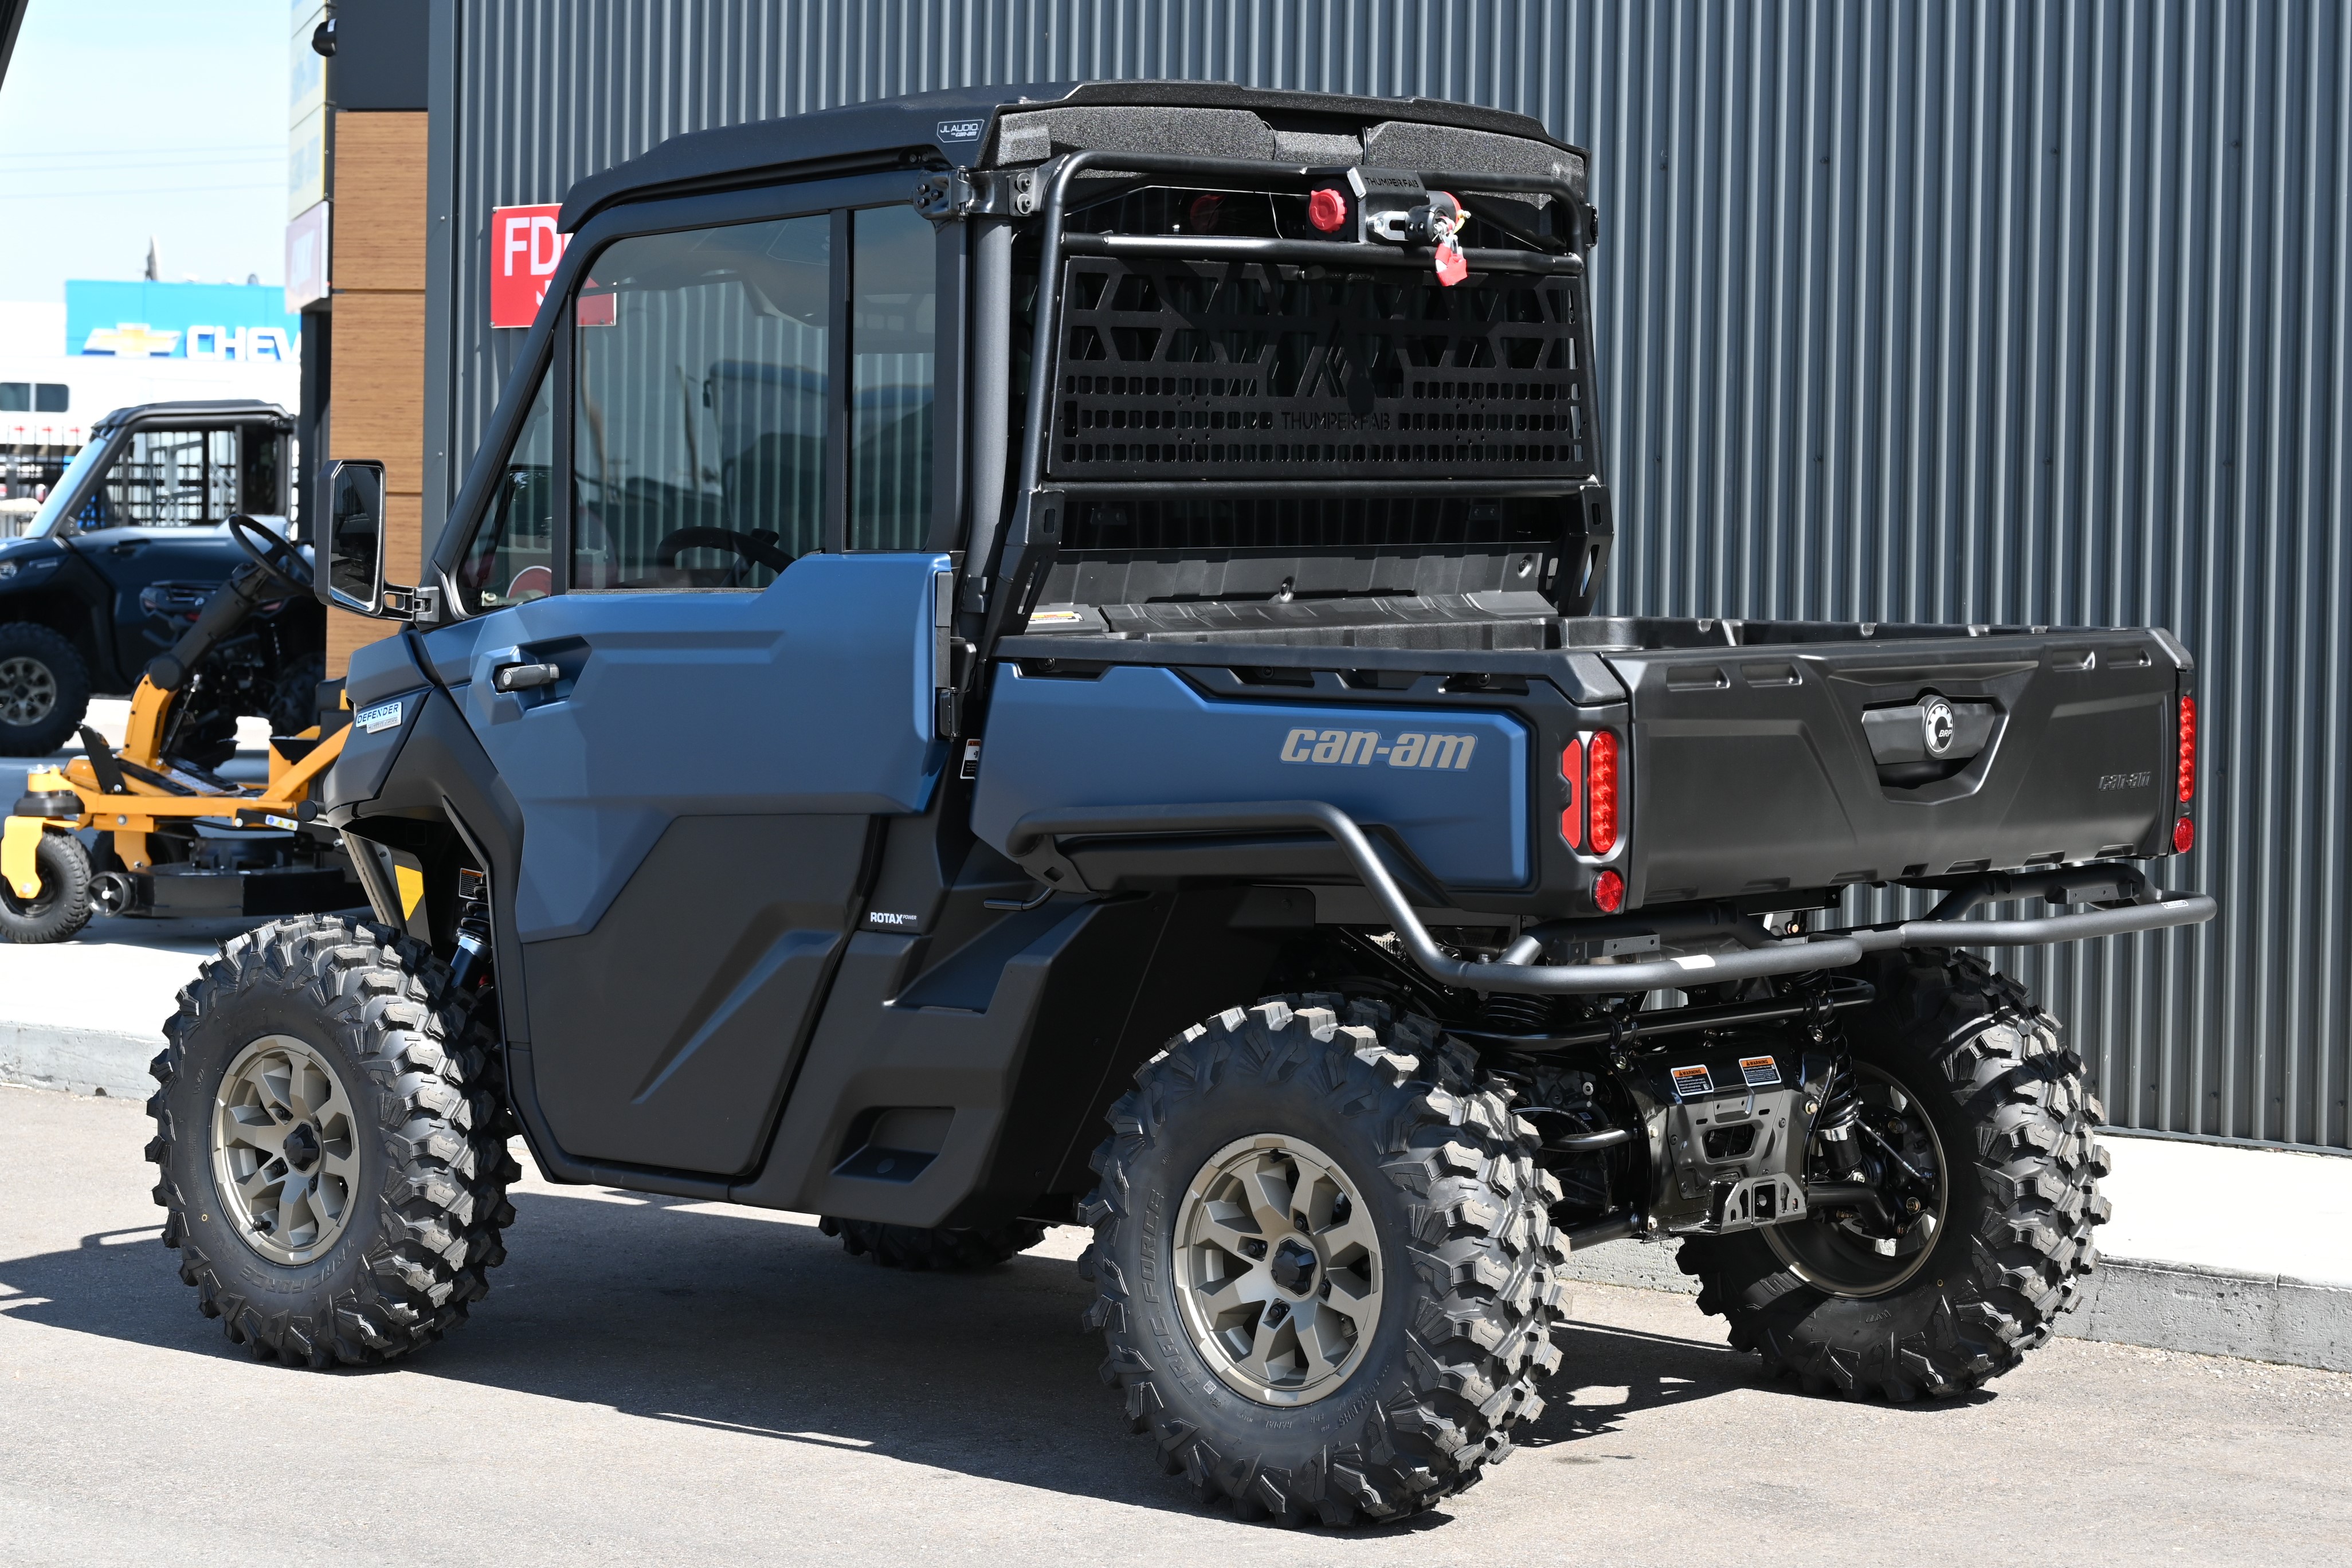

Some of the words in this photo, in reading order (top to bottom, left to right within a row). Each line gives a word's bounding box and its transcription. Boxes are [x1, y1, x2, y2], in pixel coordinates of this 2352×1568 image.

[951, 123, 978, 132] AUDIO
[504, 216, 574, 276] FD
[358, 704, 399, 724] DEFENDER
[1938, 729, 1953, 738] BRP
[1280, 729, 1476, 769] can-am
[2098, 771, 2151, 791] can-am
[871, 912, 903, 924] ROTAX
[1140, 1189, 1165, 1304] FORCE
[240, 1264, 307, 1294] FORCE
[1265, 1420, 1292, 1429] RADIAL
